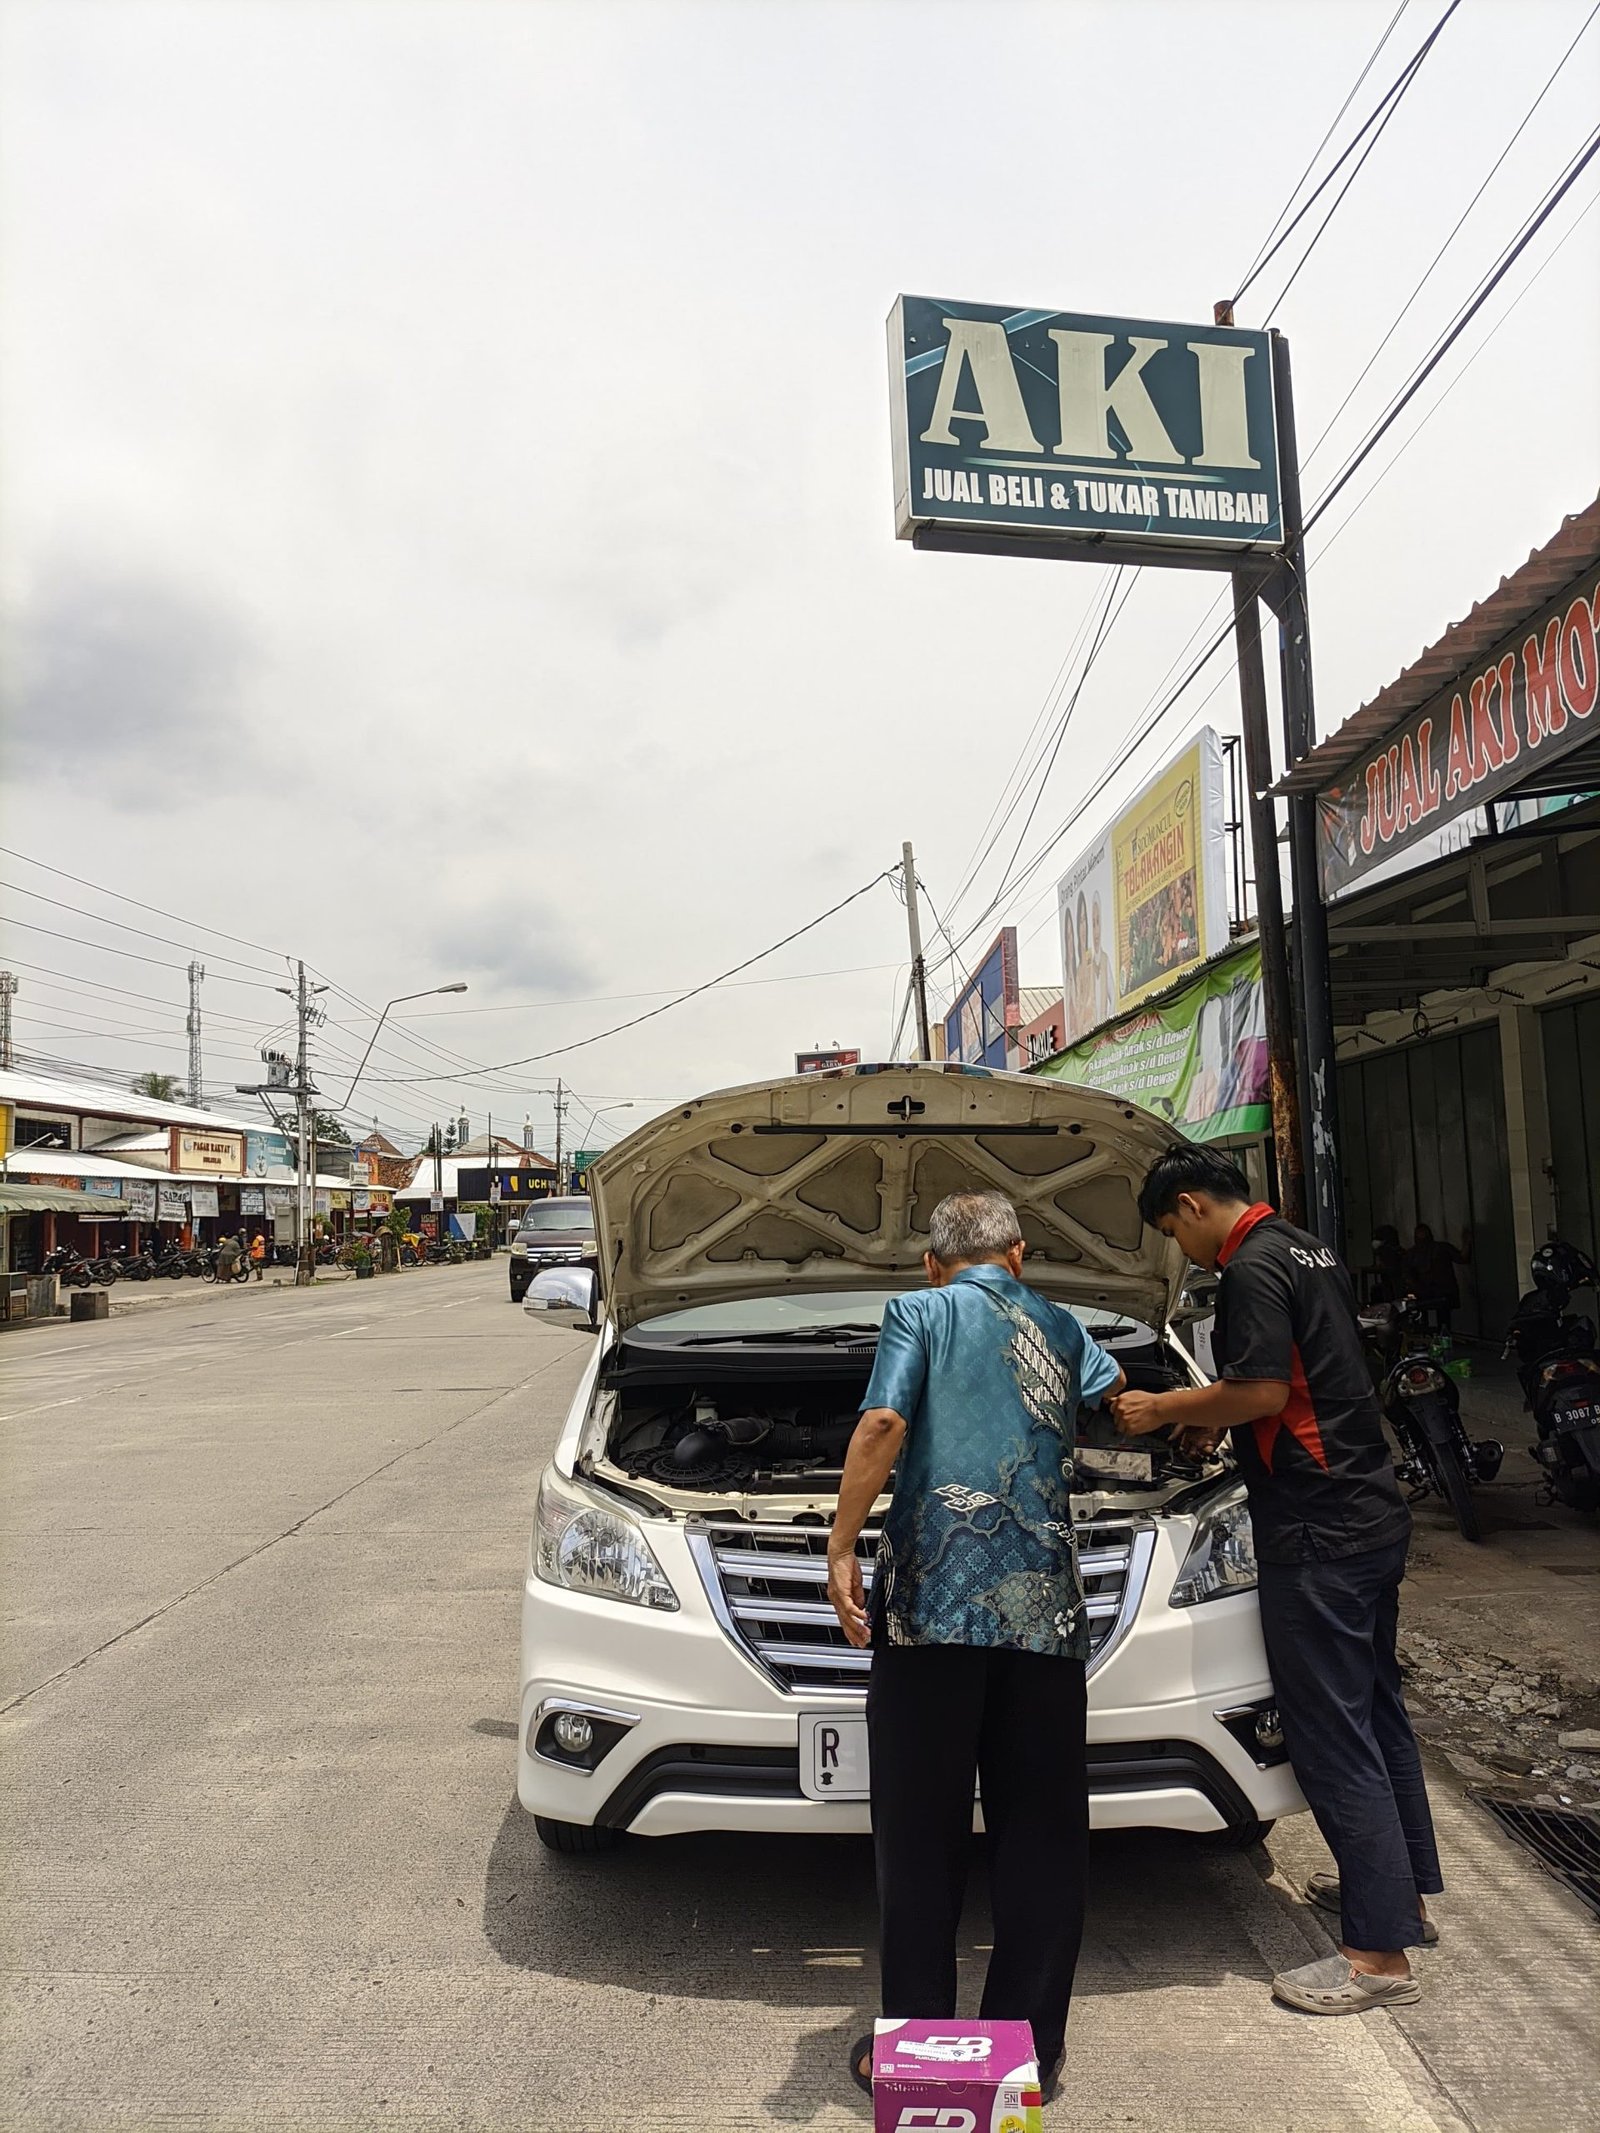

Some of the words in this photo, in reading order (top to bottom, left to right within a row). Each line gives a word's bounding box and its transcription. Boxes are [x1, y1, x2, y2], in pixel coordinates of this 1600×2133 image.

[919, 317, 1262, 470] AKI
[922, 467, 984, 505] JUAL
[988, 474, 1044, 509] BELI
[1050, 482, 1070, 511] &
[1073, 479, 1160, 517] TUKAR
[1163, 487, 1269, 525] TAMBAH
[1360, 717, 1441, 855] JUAL
[1445, 651, 1521, 802] AKI
[1522, 581, 1600, 750] MO
[1146, 1036, 1163, 1051] s/d
[1139, 1056, 1156, 1071] s/d
[1129, 1075, 1146, 1090] s/d
[1554, 1412, 1562, 1424] B
[1565, 1407, 1590, 1422] 3087
[821, 1727, 840, 1768] R
[1003, 2093, 1019, 2104] SNI
